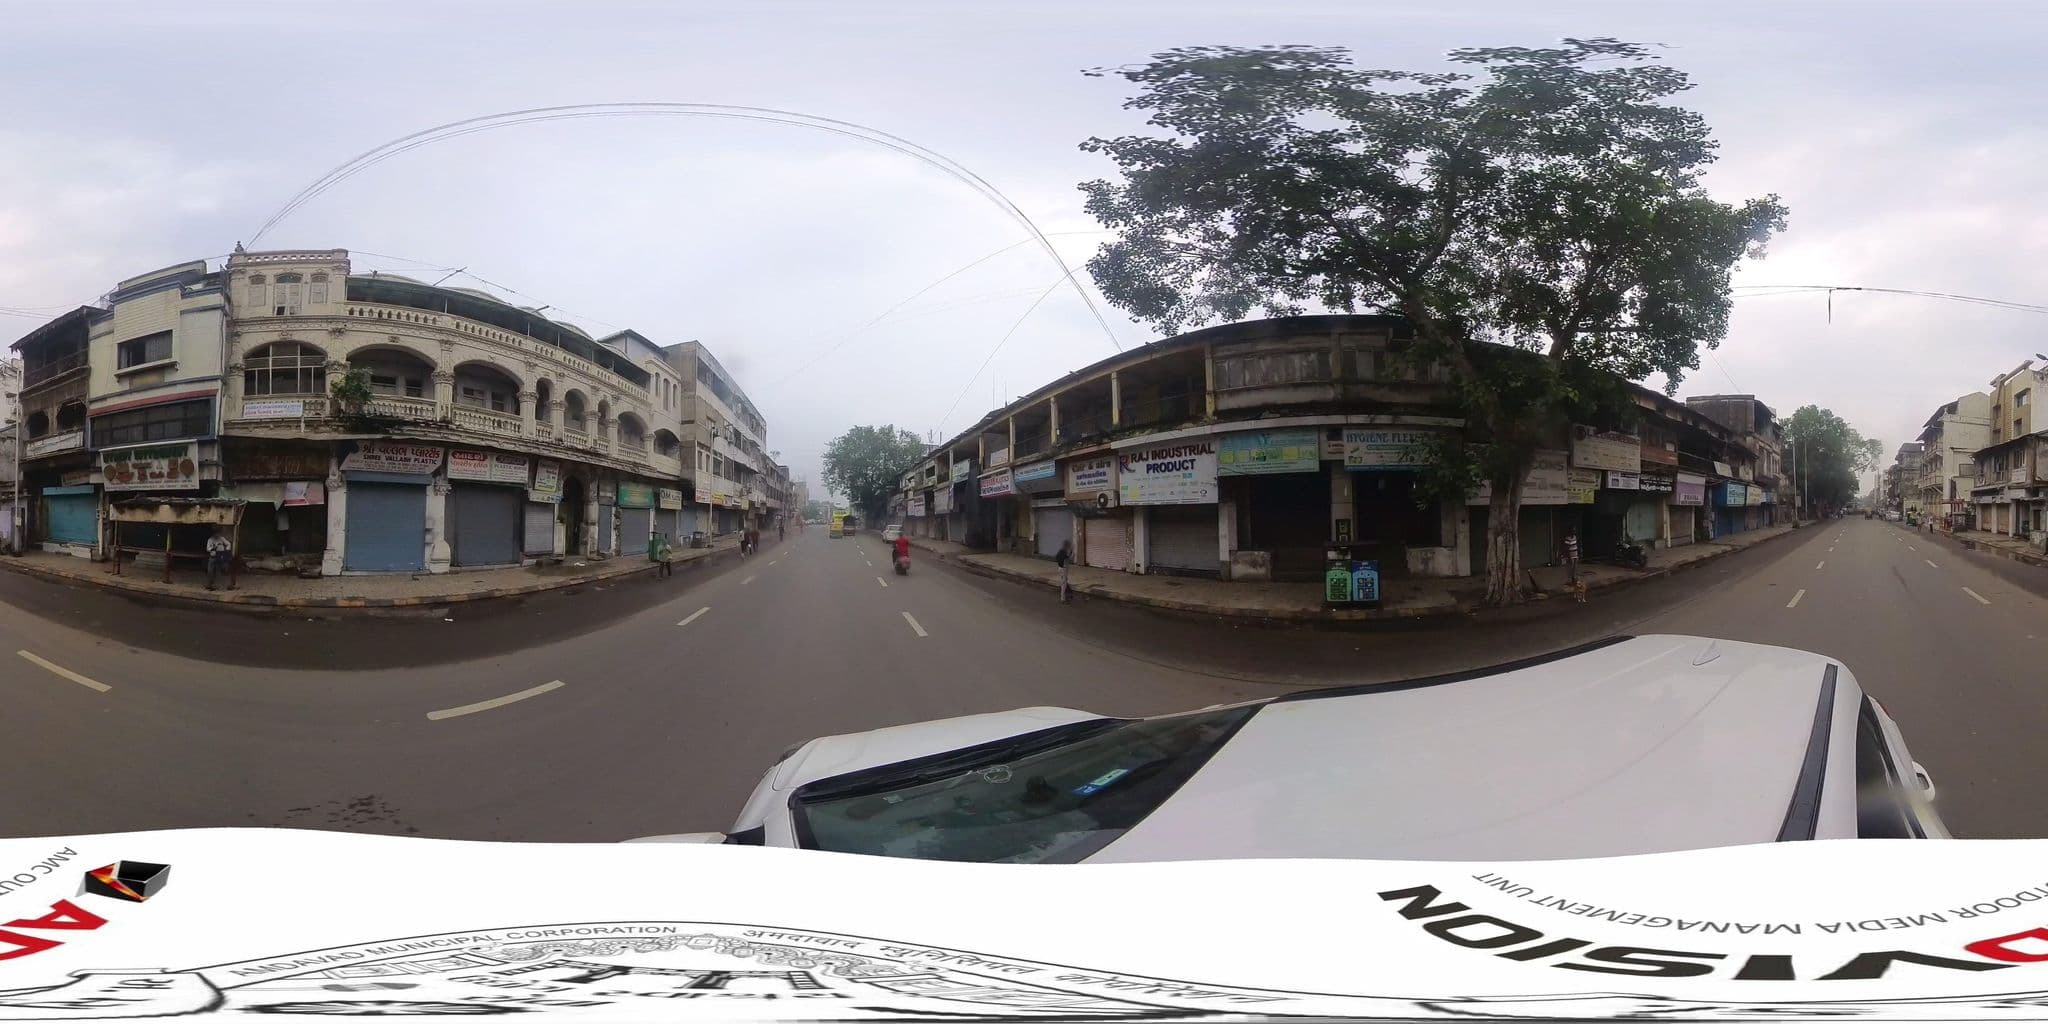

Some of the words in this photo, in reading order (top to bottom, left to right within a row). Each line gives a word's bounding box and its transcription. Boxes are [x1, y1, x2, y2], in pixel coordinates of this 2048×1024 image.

[1131, 450, 1149, 463] RAJ
[1151, 442, 1215, 460] INDUSTRIAL
[1146, 459, 1196, 474] PRODUCT
